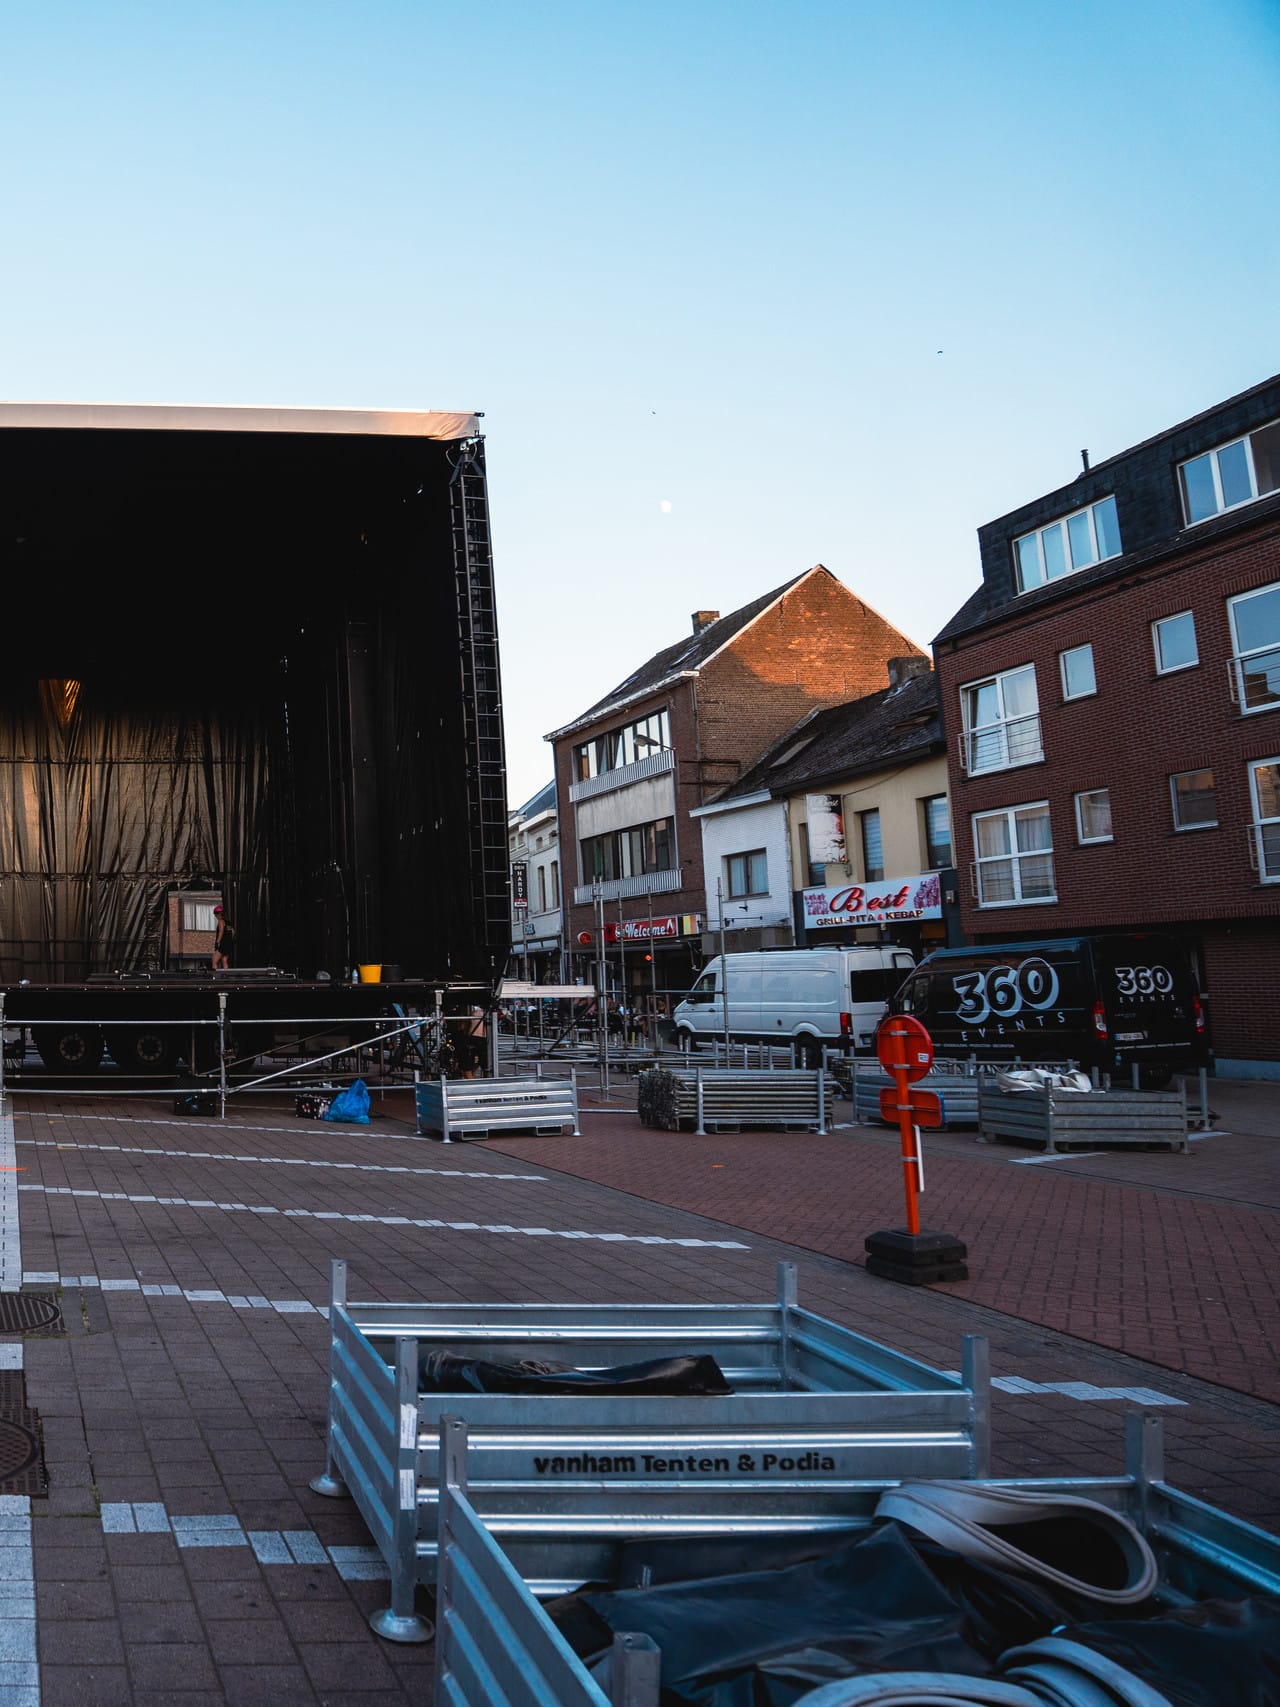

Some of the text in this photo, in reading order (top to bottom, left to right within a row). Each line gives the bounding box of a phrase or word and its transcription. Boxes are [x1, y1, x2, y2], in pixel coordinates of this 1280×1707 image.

[829, 885, 911, 913] Best
[885, 909, 924, 920] KEBAP
[952, 957, 1060, 1024] 360
[1114, 965, 1174, 995] 360
[1119, 994, 1176, 1003] EVENTS
[961, 1011, 1065, 1041] EVENTS
[533, 1452, 836, 1474] vanham Tenten & Podia
